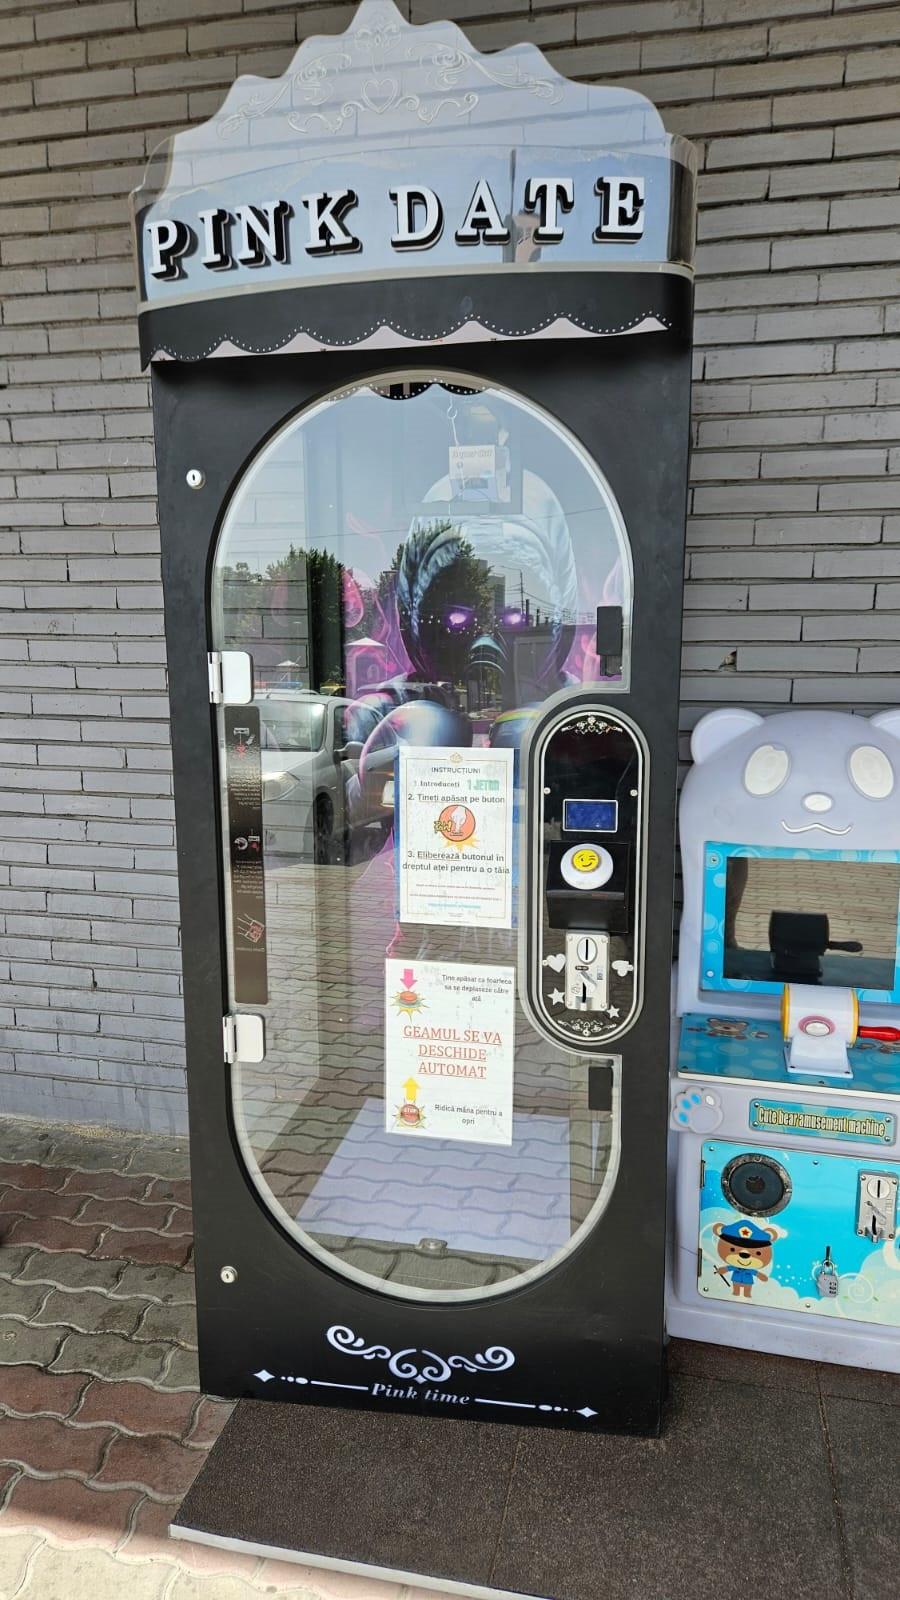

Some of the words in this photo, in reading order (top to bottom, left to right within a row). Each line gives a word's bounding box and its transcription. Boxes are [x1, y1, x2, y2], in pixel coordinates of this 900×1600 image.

[146, 189, 361, 281] PINK
[389, 176, 646, 251] DATE
[407, 793, 415, 801] 2.
[470, 796, 480, 804] pe
[481, 795, 505, 803] buton
[407, 850, 415, 858] 3.
[462, 852, 494, 861] butonul
[402, 862, 431, 871] dreptul
[450, 865, 477, 873] pentru
[403, 1025, 461, 1041] GEAMUL
[463, 1030, 480, 1043] SE
[483, 1031, 502, 1044] VA
[418, 1044, 487, 1061] DESCHIDE
[418, 1062, 487, 1078] AUTOMAT
[475, 1107, 497, 1116] pentru
[461, 1117, 475, 1125] opri
[759, 1107, 777, 1124] Cute
[778, 1110, 798, 1127] bear
[798, 1114, 847, 1133] amusement
[847, 1118, 886, 1137] machine
[371, 1383, 418, 1399] Pink
[424, 1389, 470, 1405] time
